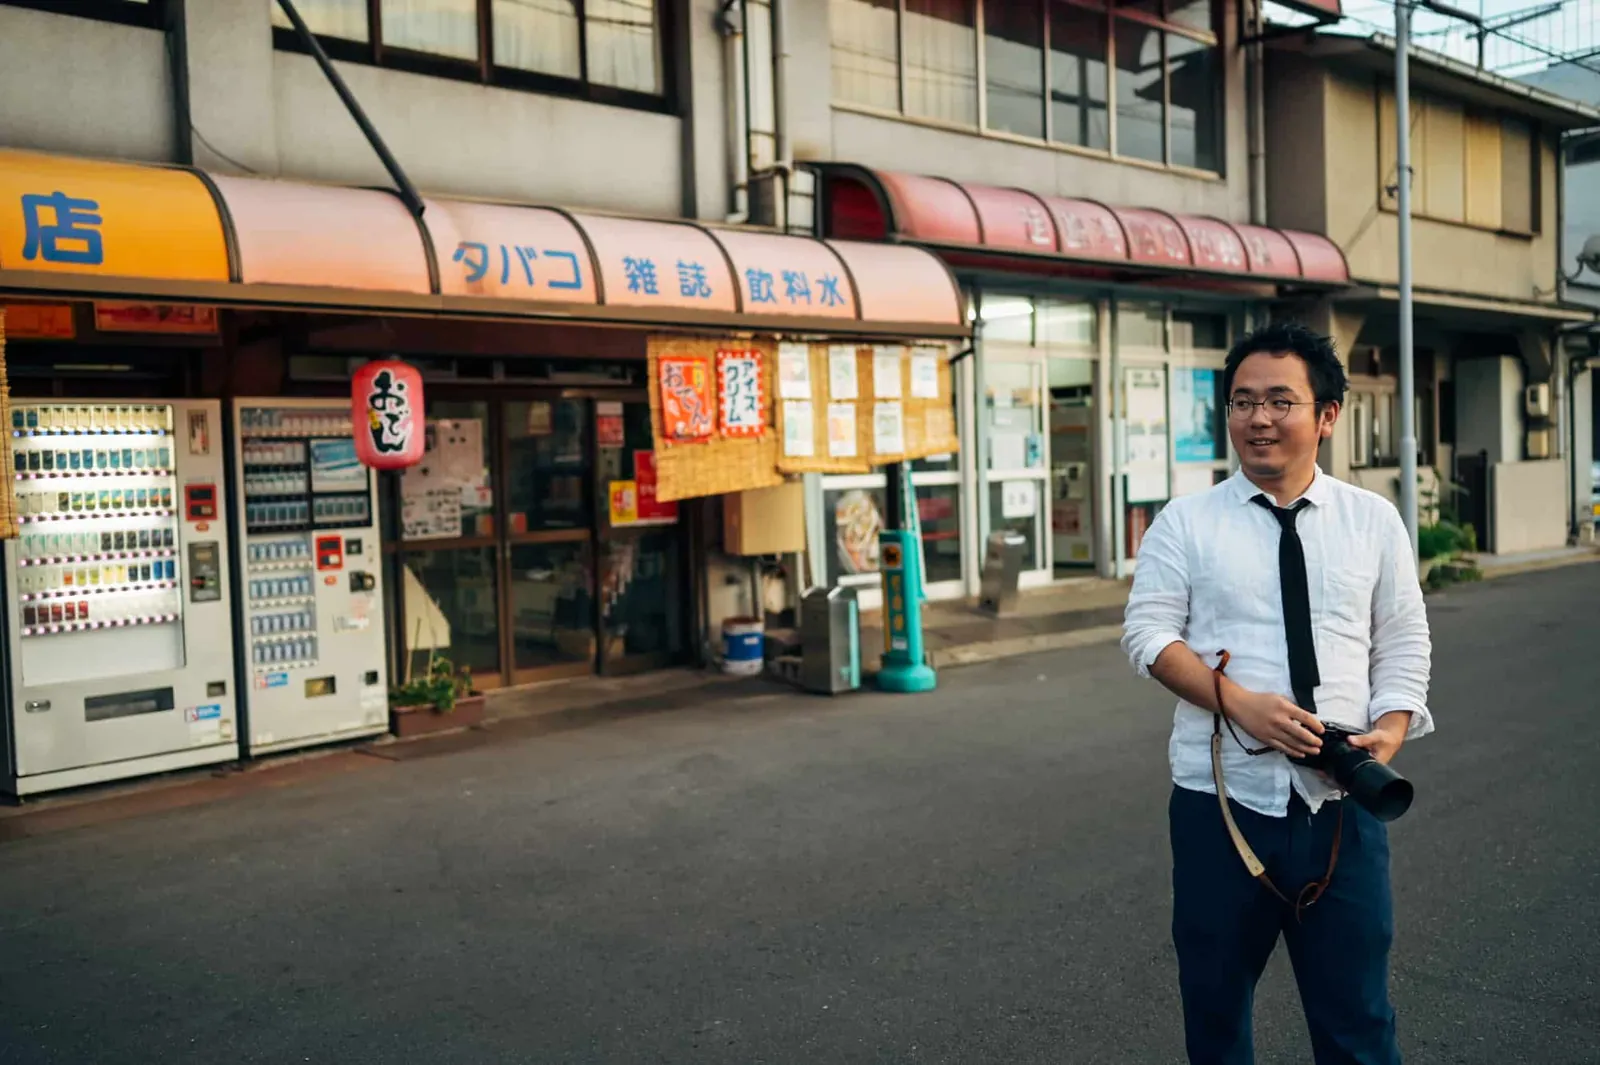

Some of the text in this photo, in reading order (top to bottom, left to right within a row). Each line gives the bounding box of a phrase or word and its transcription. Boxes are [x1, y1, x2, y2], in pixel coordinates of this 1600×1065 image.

[21, 191, 103, 265] 店
[452, 241, 845, 306] タバコ 雑誌 飲料水
[369, 371, 409, 453] おでん
